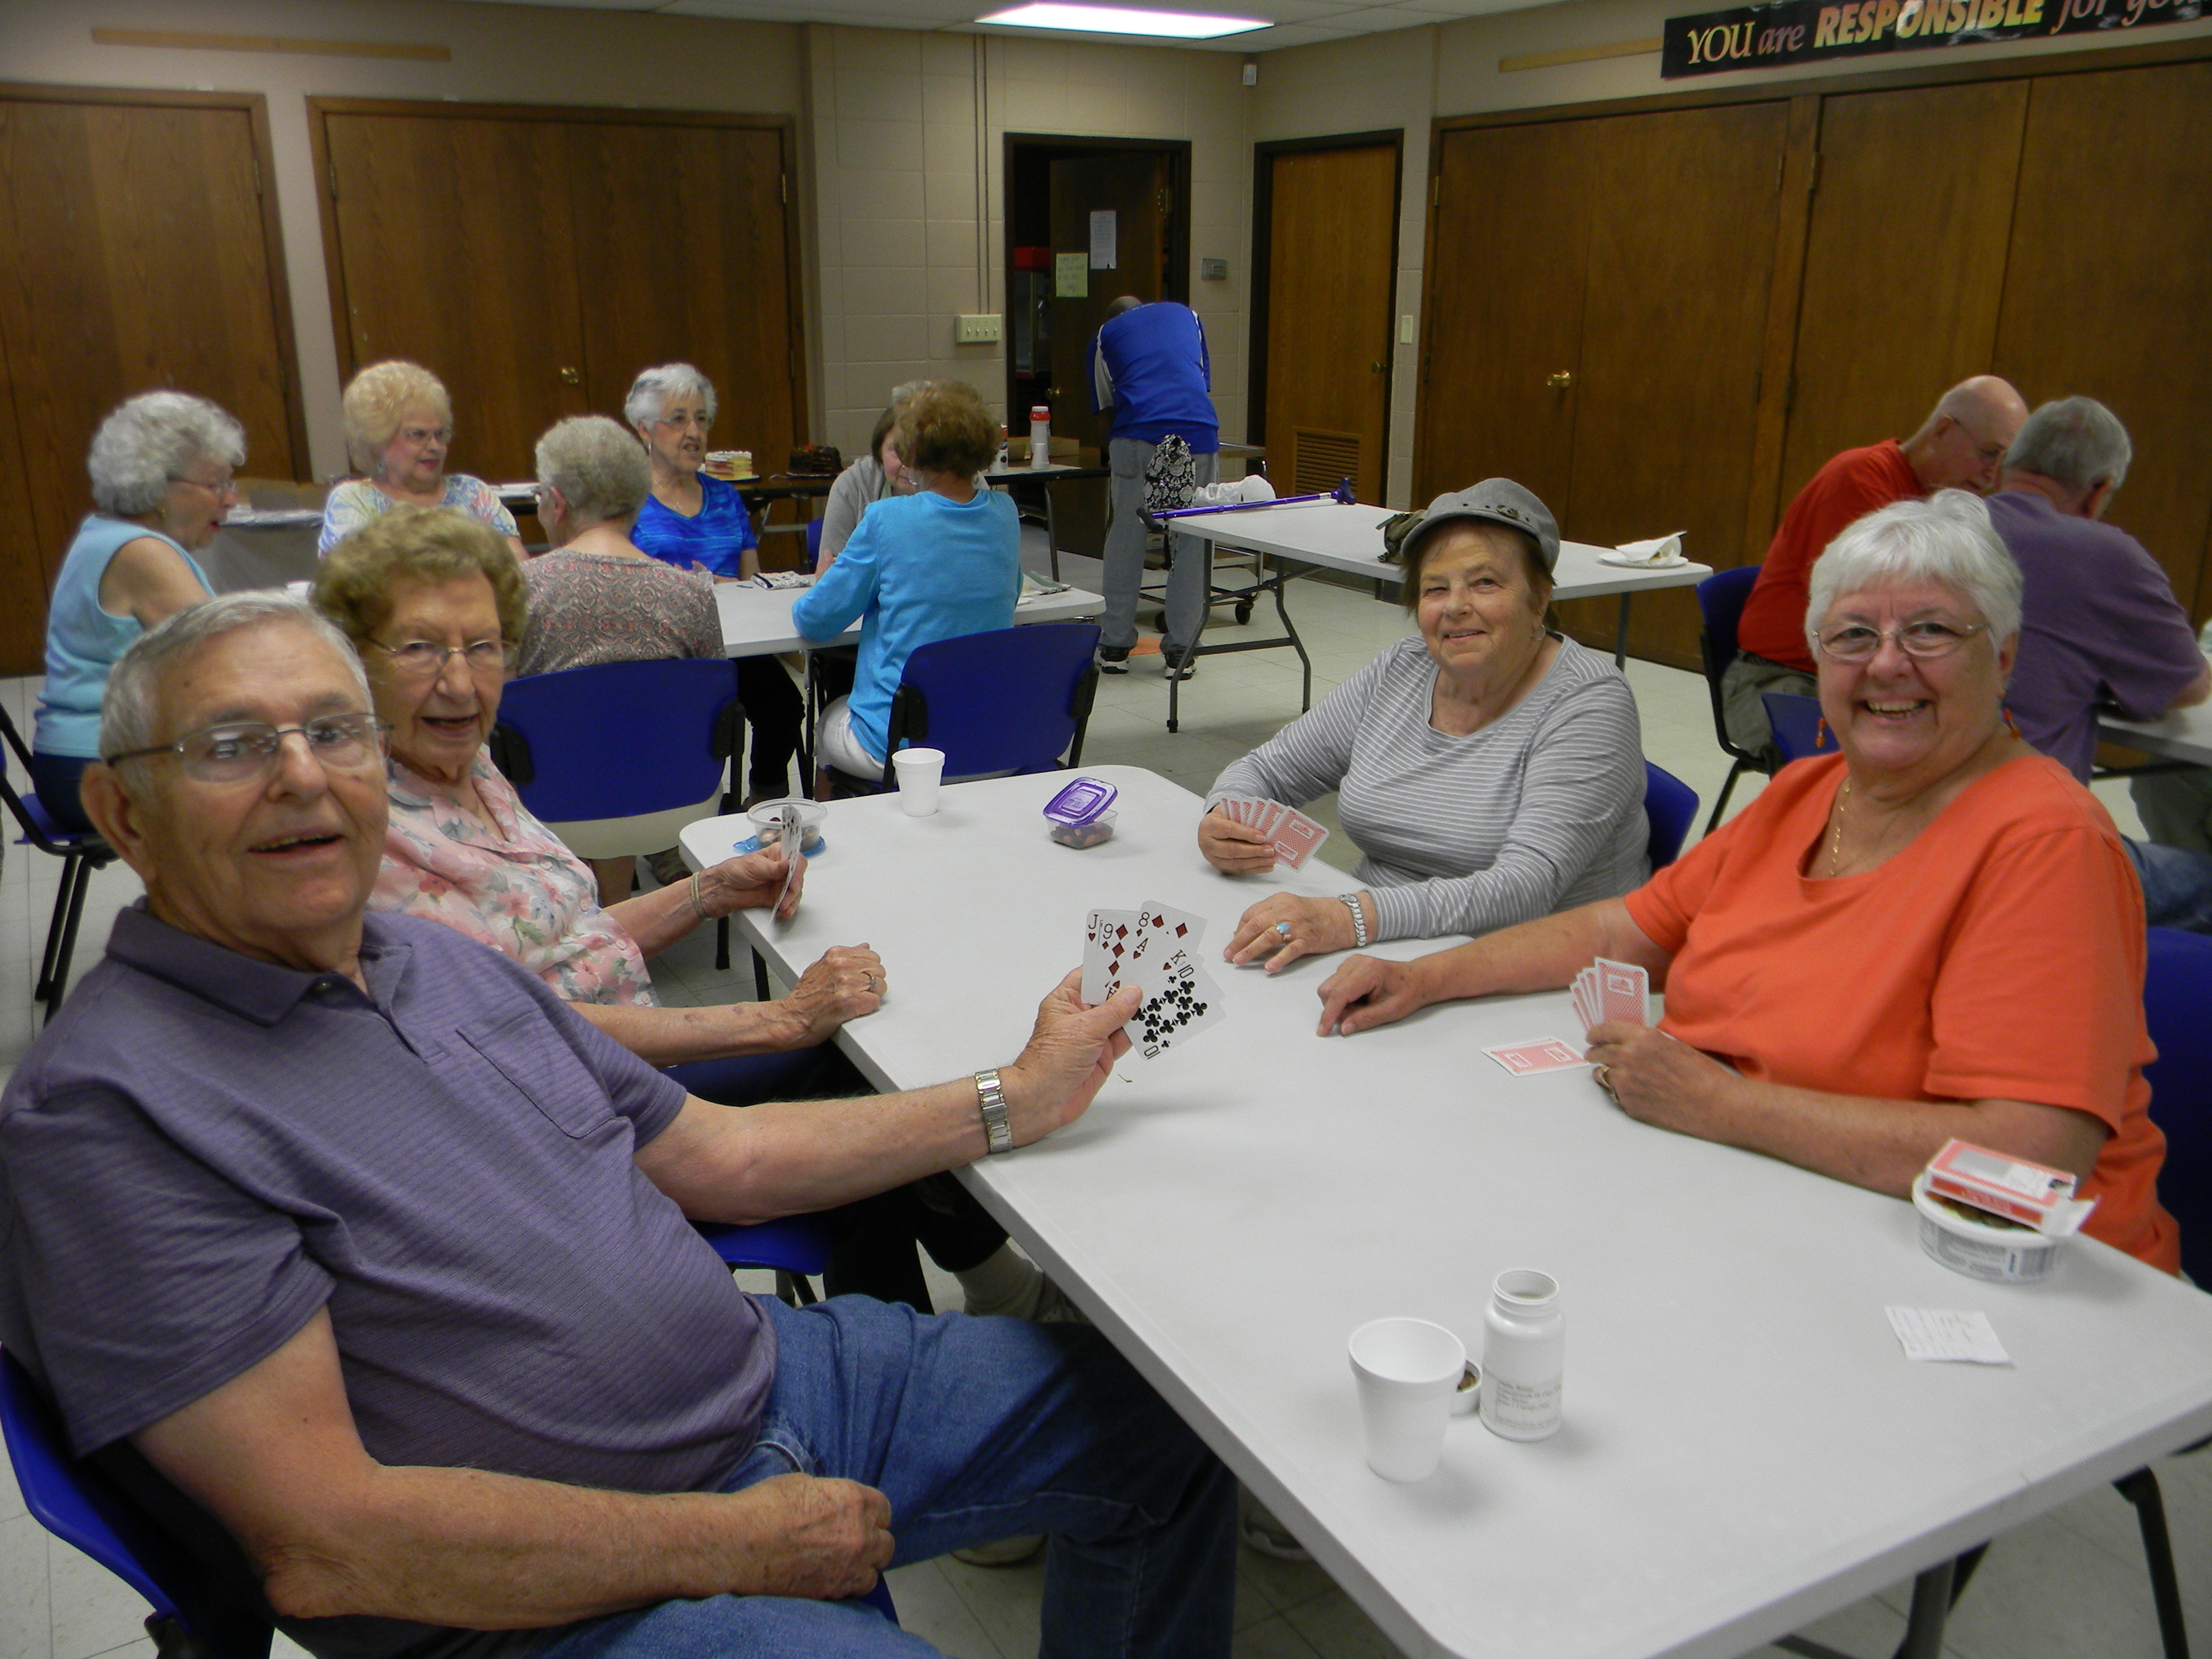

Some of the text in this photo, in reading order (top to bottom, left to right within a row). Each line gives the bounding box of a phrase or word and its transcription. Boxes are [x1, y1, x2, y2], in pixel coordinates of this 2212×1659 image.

[1688, 21, 1755, 65] YOU
[1757, 24, 1806, 55] are
[1813, 0, 2044, 48] RESPONSIBLE
[1088, 914, 1098, 929] J
[1139, 912, 1150, 927] 8
[1103, 923, 1113, 939] 9
[1136, 937, 1149, 952] A
[1170, 950, 1187, 965] K
[1177, 964, 1194, 978] 10
[1144, 1045, 1161, 1060] 10
